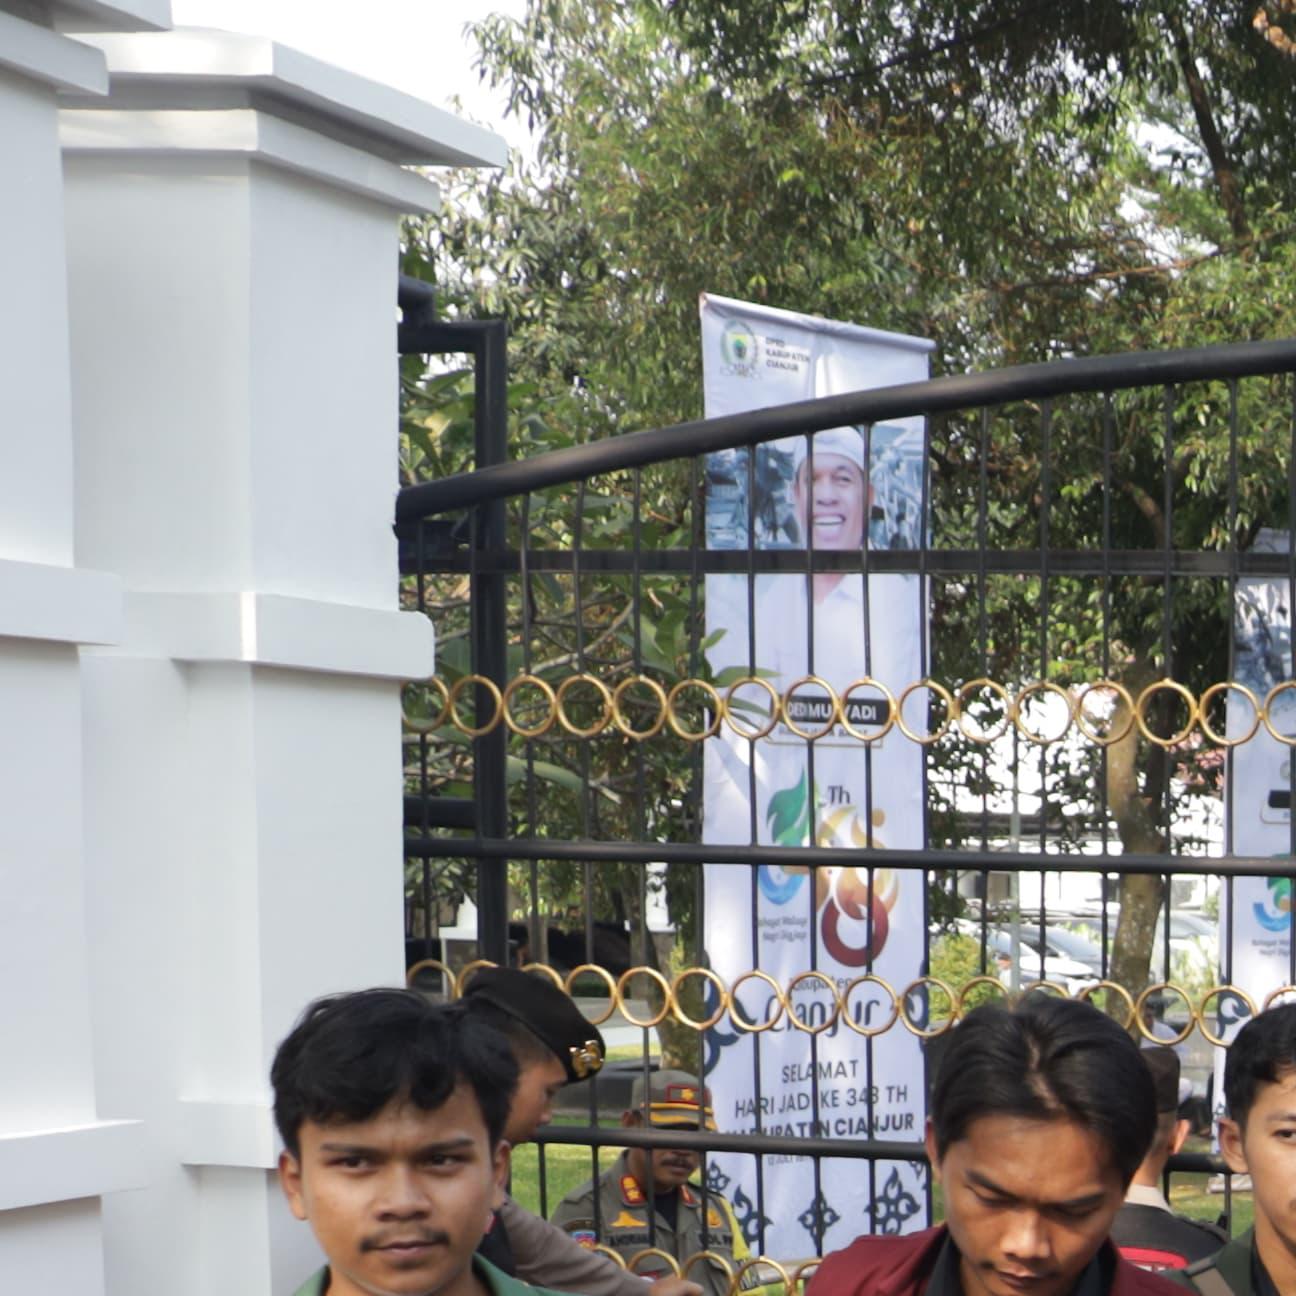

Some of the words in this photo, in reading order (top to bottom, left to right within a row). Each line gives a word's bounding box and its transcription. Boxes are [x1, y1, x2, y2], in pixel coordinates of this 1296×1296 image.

[809, 703, 877, 721] MUADI
[782, 1060, 859, 1084] SELAMAT
[735, 1097, 775, 1119] HARI
[779, 1092, 814, 1114] JAD
[820, 1089, 840, 1109] KE
[886, 1085, 908, 1104] TH
[834, 1112, 915, 1137] CIANJUR
